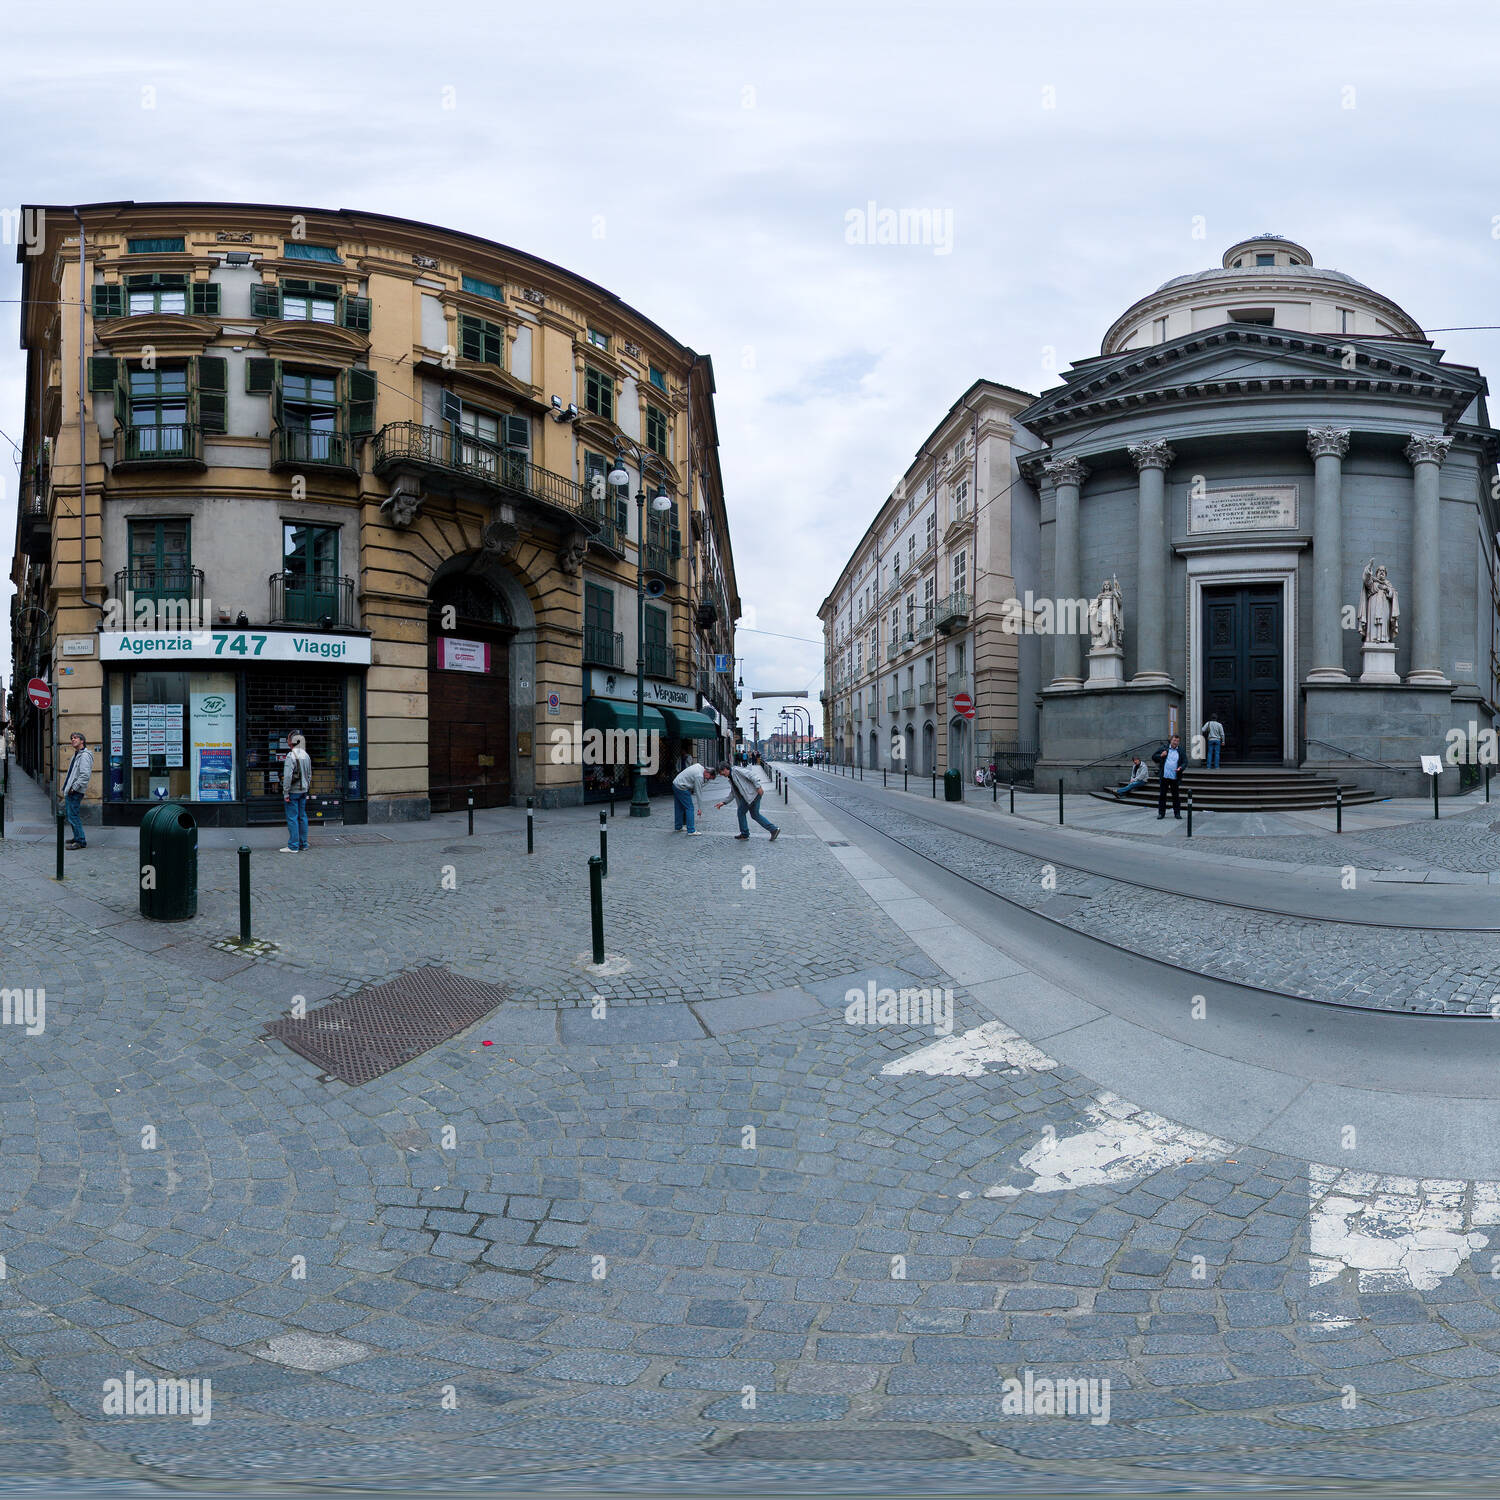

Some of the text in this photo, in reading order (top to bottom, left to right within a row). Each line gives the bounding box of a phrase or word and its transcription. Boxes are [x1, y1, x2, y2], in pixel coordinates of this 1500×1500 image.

[119, 634, 346, 658] Agenzia 747 Viaggi
[653, 683, 689, 704] Vergnano
[205, 700, 222, 709] 747
